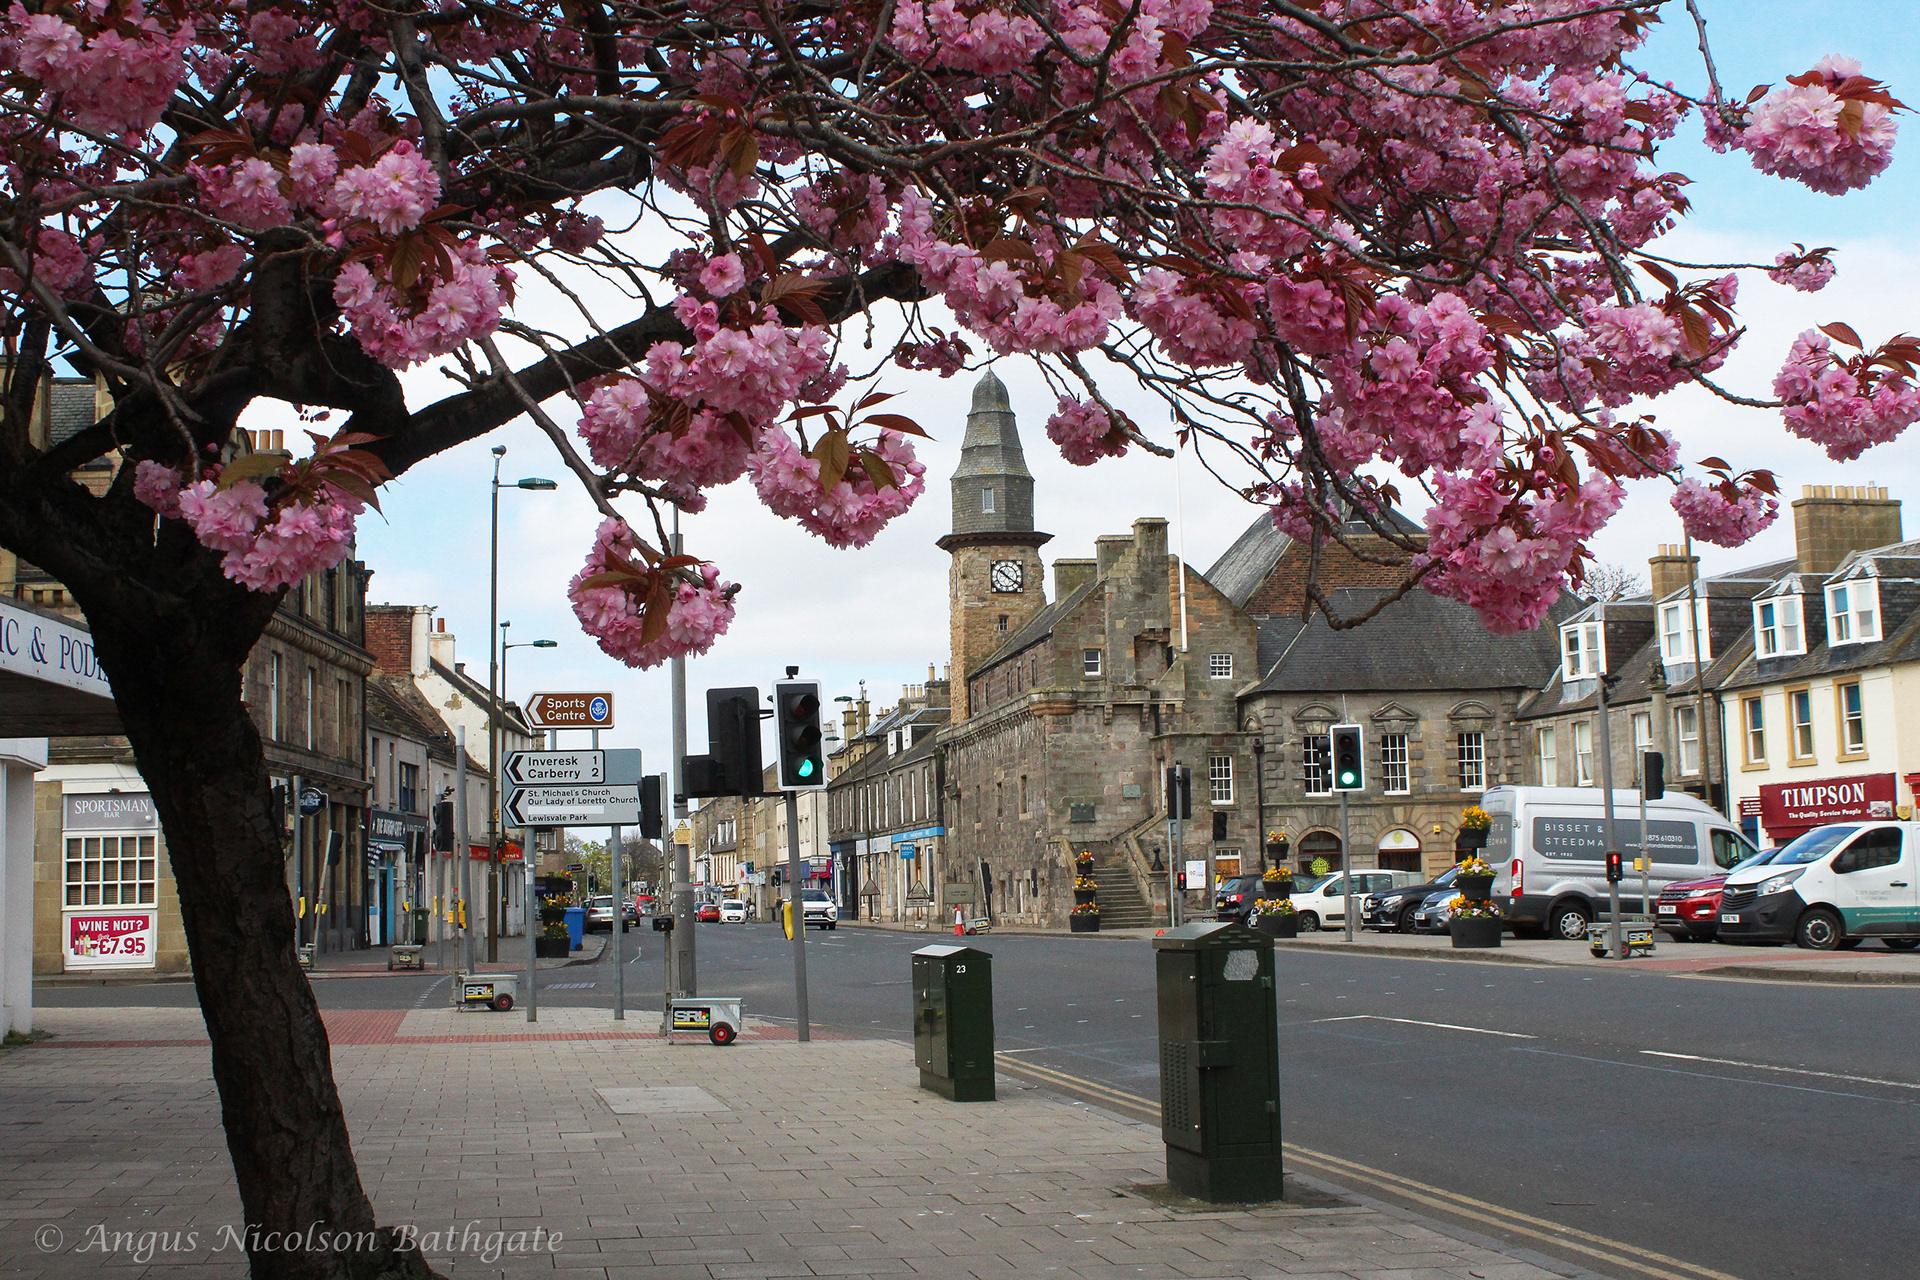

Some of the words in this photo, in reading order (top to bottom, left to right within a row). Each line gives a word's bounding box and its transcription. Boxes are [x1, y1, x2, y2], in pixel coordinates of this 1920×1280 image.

[31, 626, 48, 664] &
[59, 634, 109, 682] POD
[547, 698, 586, 709] Sports
[546, 710, 586, 720] Centre
[528, 756, 578, 766] Inveresk
[592, 755, 598, 765] 1
[528, 768, 581, 779] Carberry
[591, 767, 599, 777] 2
[543, 789, 579, 797] Michael's
[1781, 782, 1865, 807] TIMPSON
[75, 799, 149, 814] SPORTSMAN
[546, 798, 564, 806] Lady
[609, 796, 638, 804] Church
[528, 814, 567, 822] Lewisvale
[1799, 811, 1818, 819] Quality
[1842, 808, 1861, 816] People
[1544, 823, 1590, 832] BISSET
[1597, 825, 1604, 833] &
[1544, 837, 1604, 847] STEEDMA
[78, 920, 109, 931] WINE
[113, 919, 144, 931] NOT?
[1629, 932, 1652, 941] SRL
[99, 937, 146, 954] £7.95
[956, 965, 966, 973] 23
[466, 986, 493, 995] SRL
[674, 1010, 708, 1021] SRL
